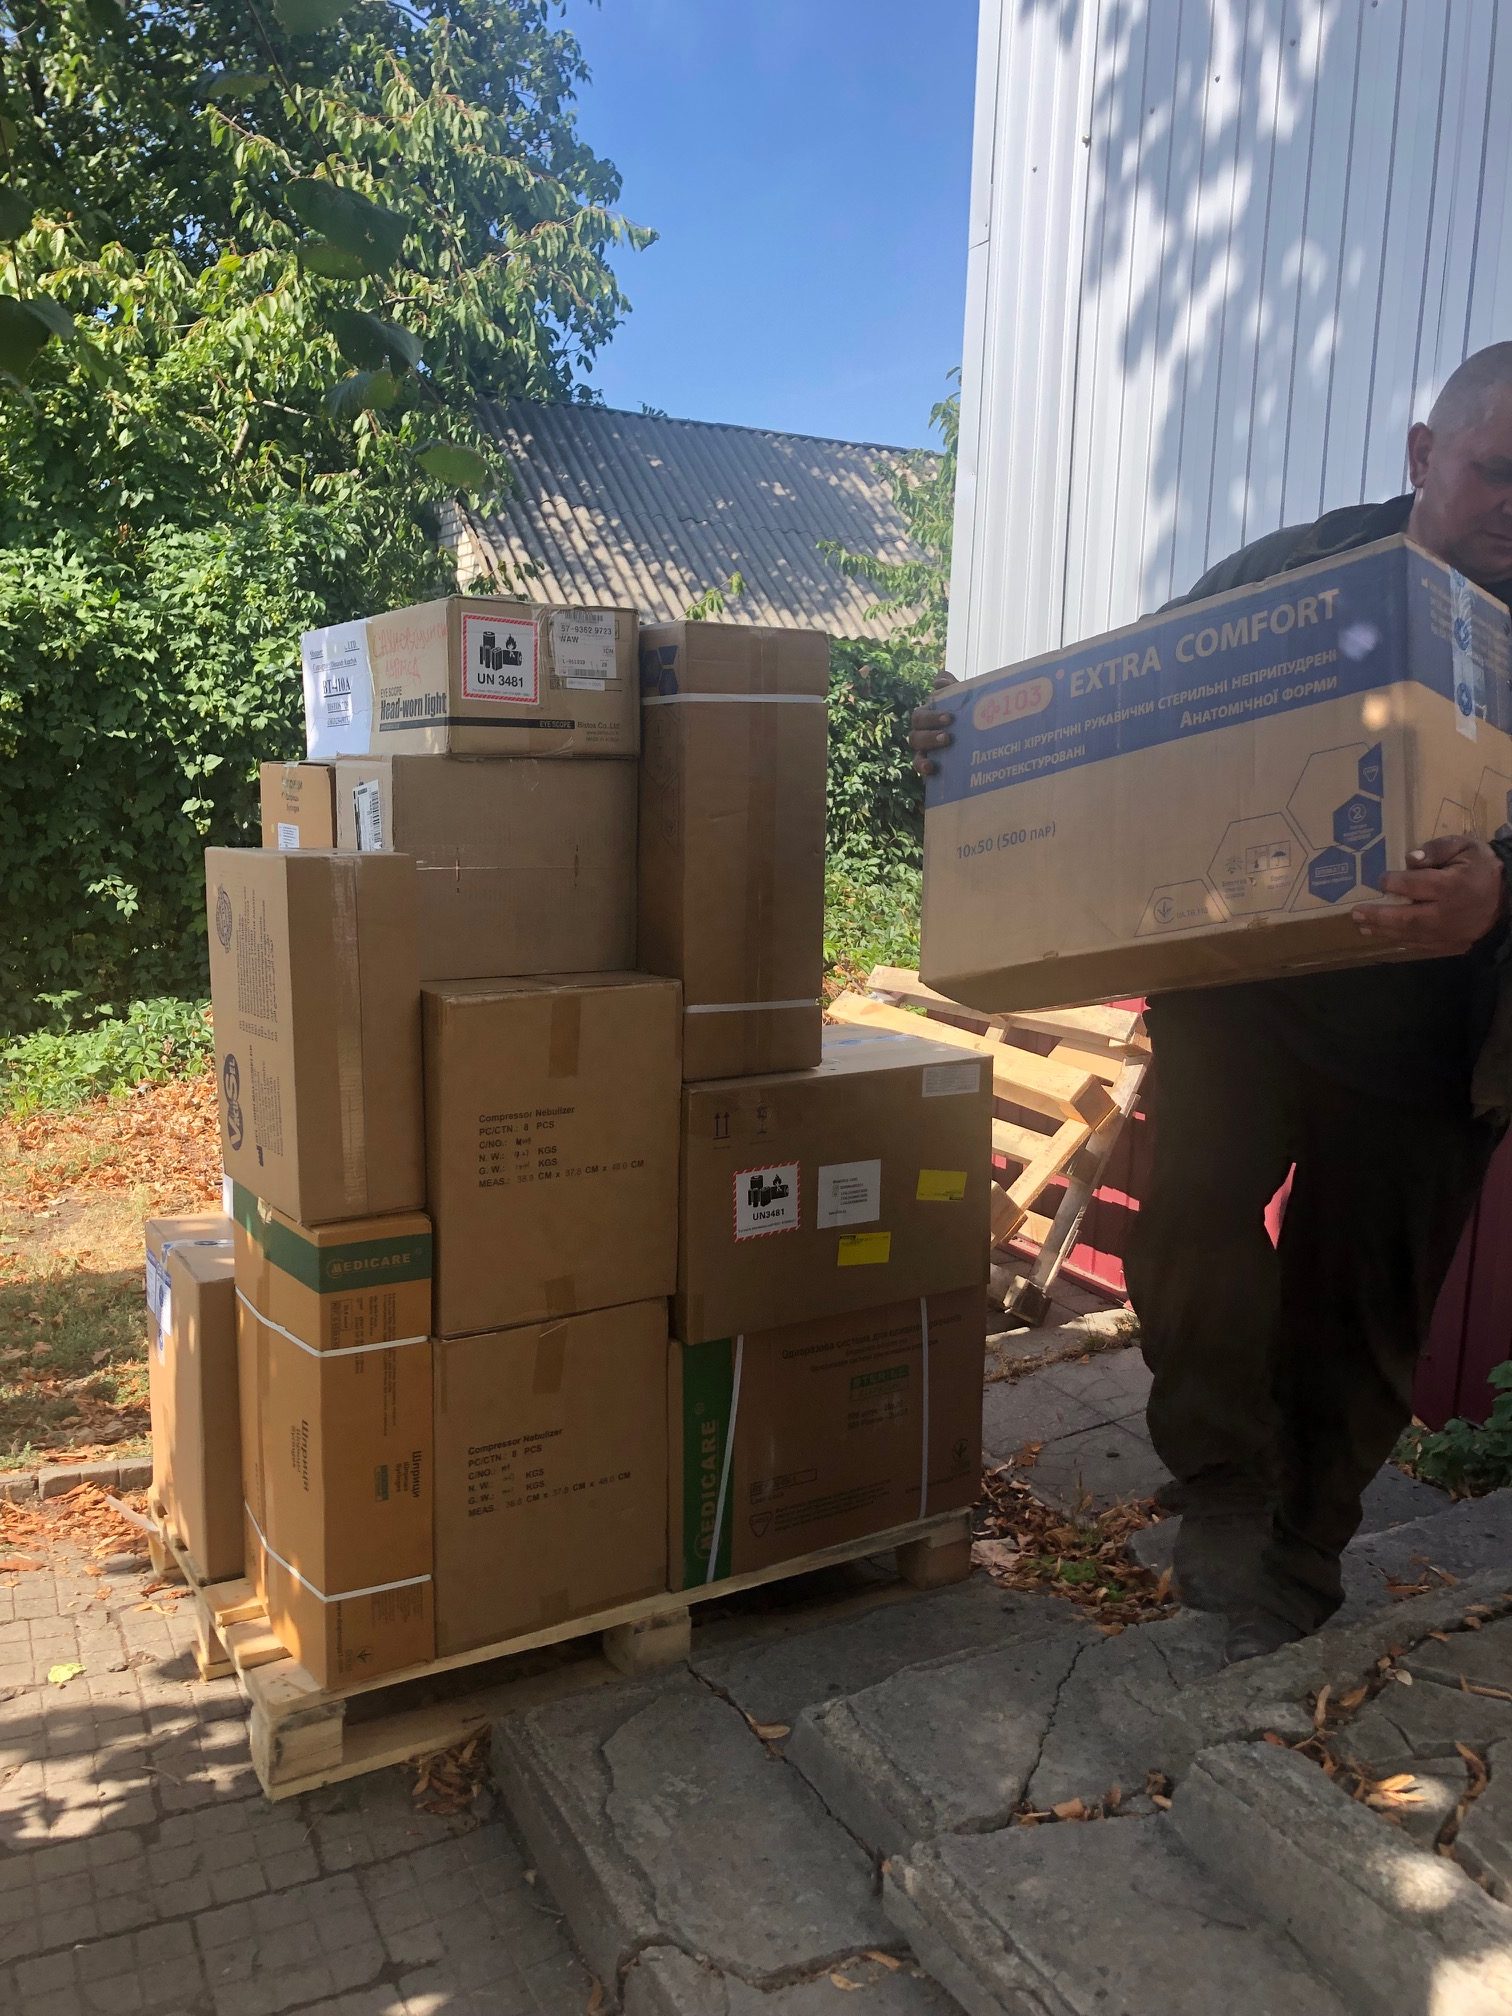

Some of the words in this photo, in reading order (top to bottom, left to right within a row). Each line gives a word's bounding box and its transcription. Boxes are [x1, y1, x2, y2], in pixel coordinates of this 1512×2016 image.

[1070, 645, 1162, 698] EXTRA
[1175, 588, 1340, 663] COMFORT
[478, 673, 495, 685] UN
[498, 675, 524, 688] 3481
[381, 698, 423, 720] Head-worn
[425, 691, 447, 717] light
[1002, 684, 1042, 717] 103
[997, 828, 1026, 850] (500
[479, 1111, 532, 1124] Compressor
[535, 1106, 576, 1117] Nebulizer
[536, 1121, 555, 1130] PCS
[538, 1146, 557, 1155] KGS
[538, 1158, 558, 1167] KGS
[538, 1172, 552, 1181] CM
[585, 1165, 599, 1174] CM
[631, 1159, 644, 1169] CM
[752, 1208, 786, 1222] UN3481
[330, 1252, 412, 1276] MEDICARE
[468, 1437, 522, 1455] Compressor
[523, 1428, 563, 1443] Nebulizer
[524, 1444, 543, 1455] PCS
[525, 1469, 545, 1479] KGS
[526, 1481, 545, 1490] KGS
[526, 1493, 540, 1503] CM
[572, 1482, 586, 1492] CM
[618, 1471, 631, 1481] CM
